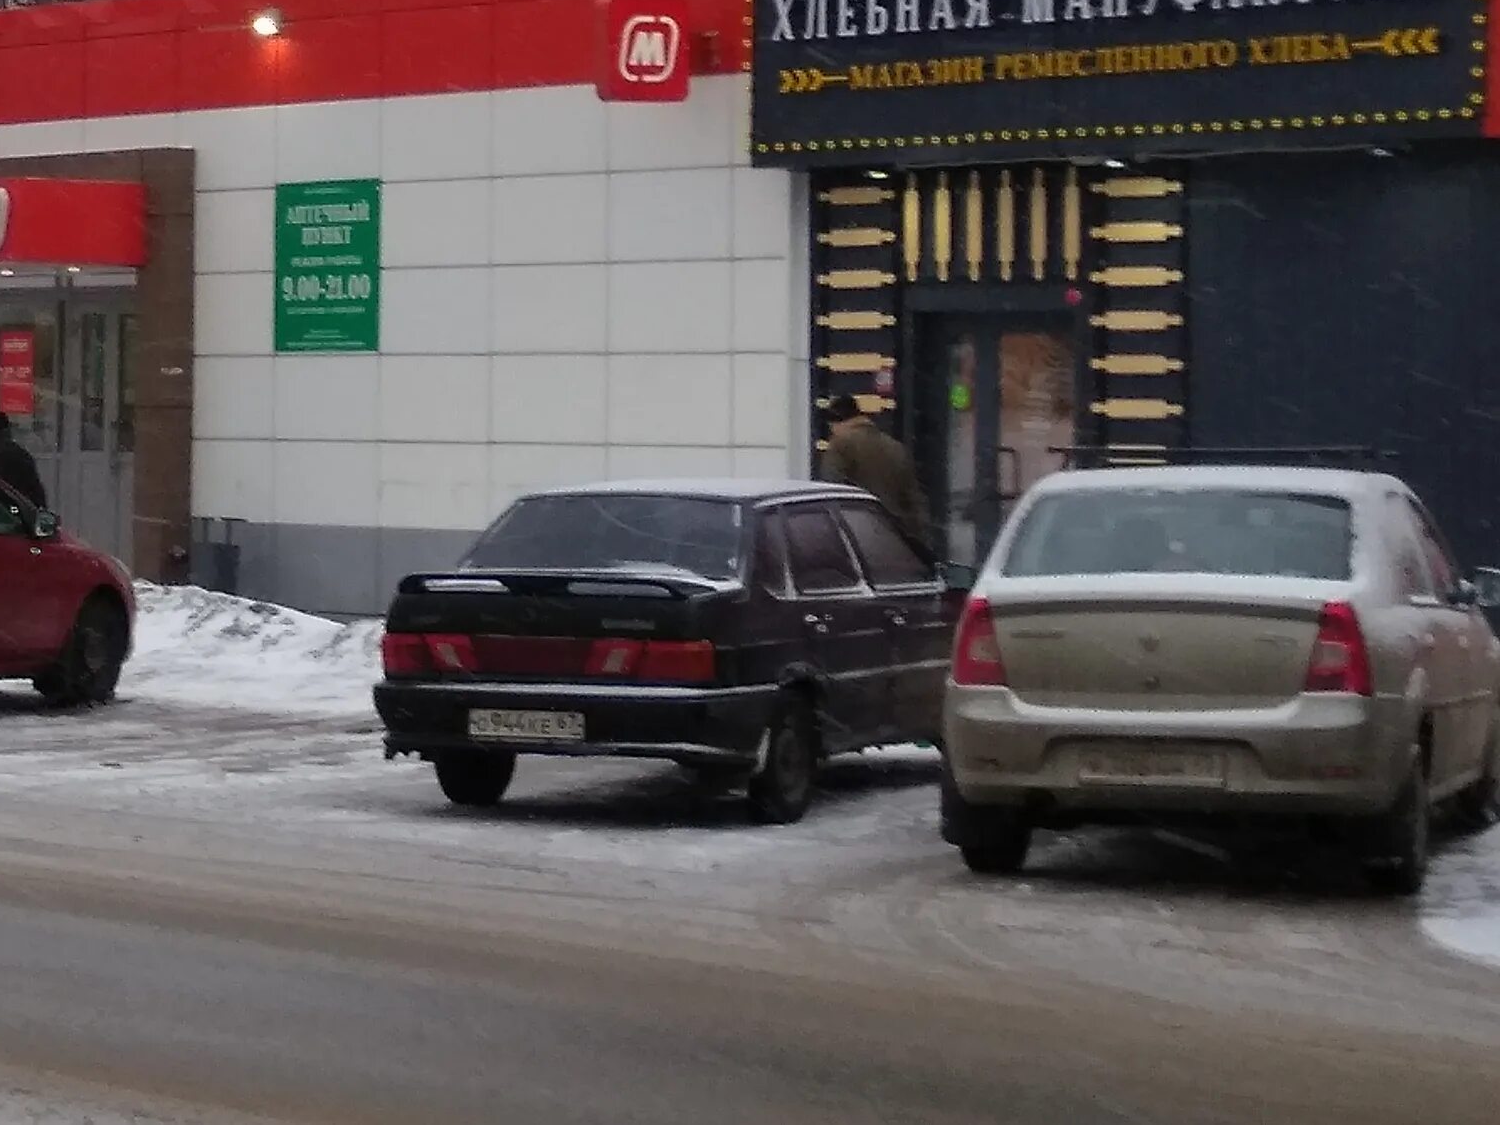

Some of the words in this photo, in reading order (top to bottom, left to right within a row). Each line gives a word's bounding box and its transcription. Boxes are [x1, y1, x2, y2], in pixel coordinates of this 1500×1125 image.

[849, 55, 985, 90] МАГАЗИН
[995, 39, 1238, 79] РЕМЕСЛЕННОГО
[1249, 32, 1351, 64] ХЛЕБА
